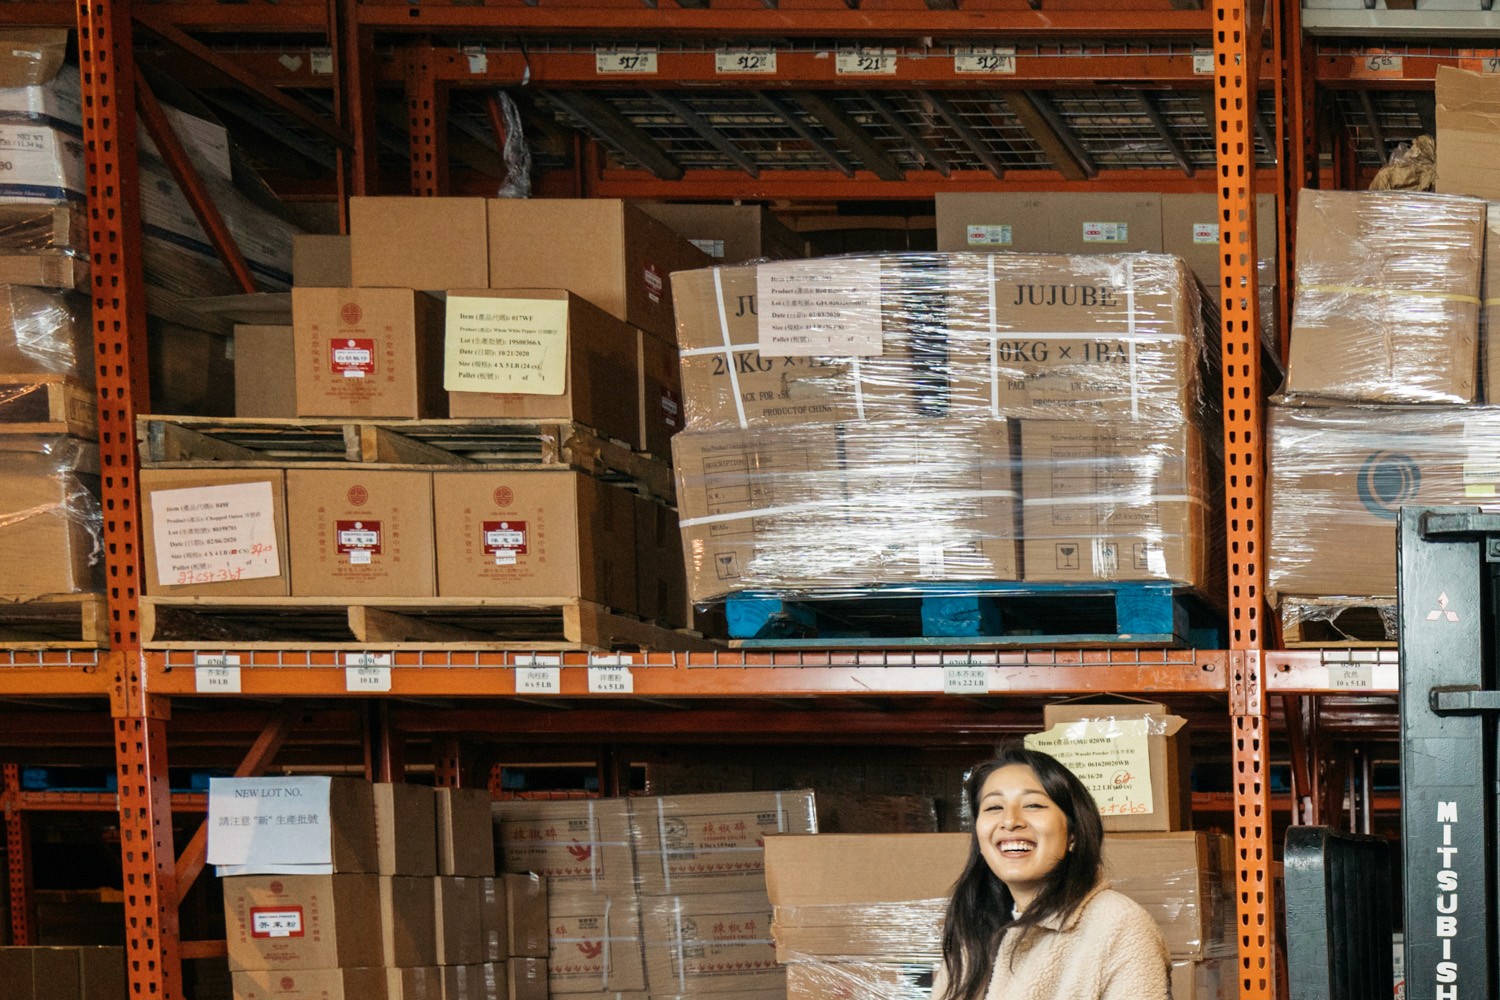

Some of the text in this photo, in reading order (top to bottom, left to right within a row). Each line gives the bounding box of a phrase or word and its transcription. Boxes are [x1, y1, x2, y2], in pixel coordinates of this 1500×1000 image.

[618, 56, 638, 70] $17
[737, 56, 759, 70] $12
[857, 56, 880, 70] $21
[1014, 284, 1118, 307] JUJUBE
[234, 788, 303, 798] NEW LOT NO.
